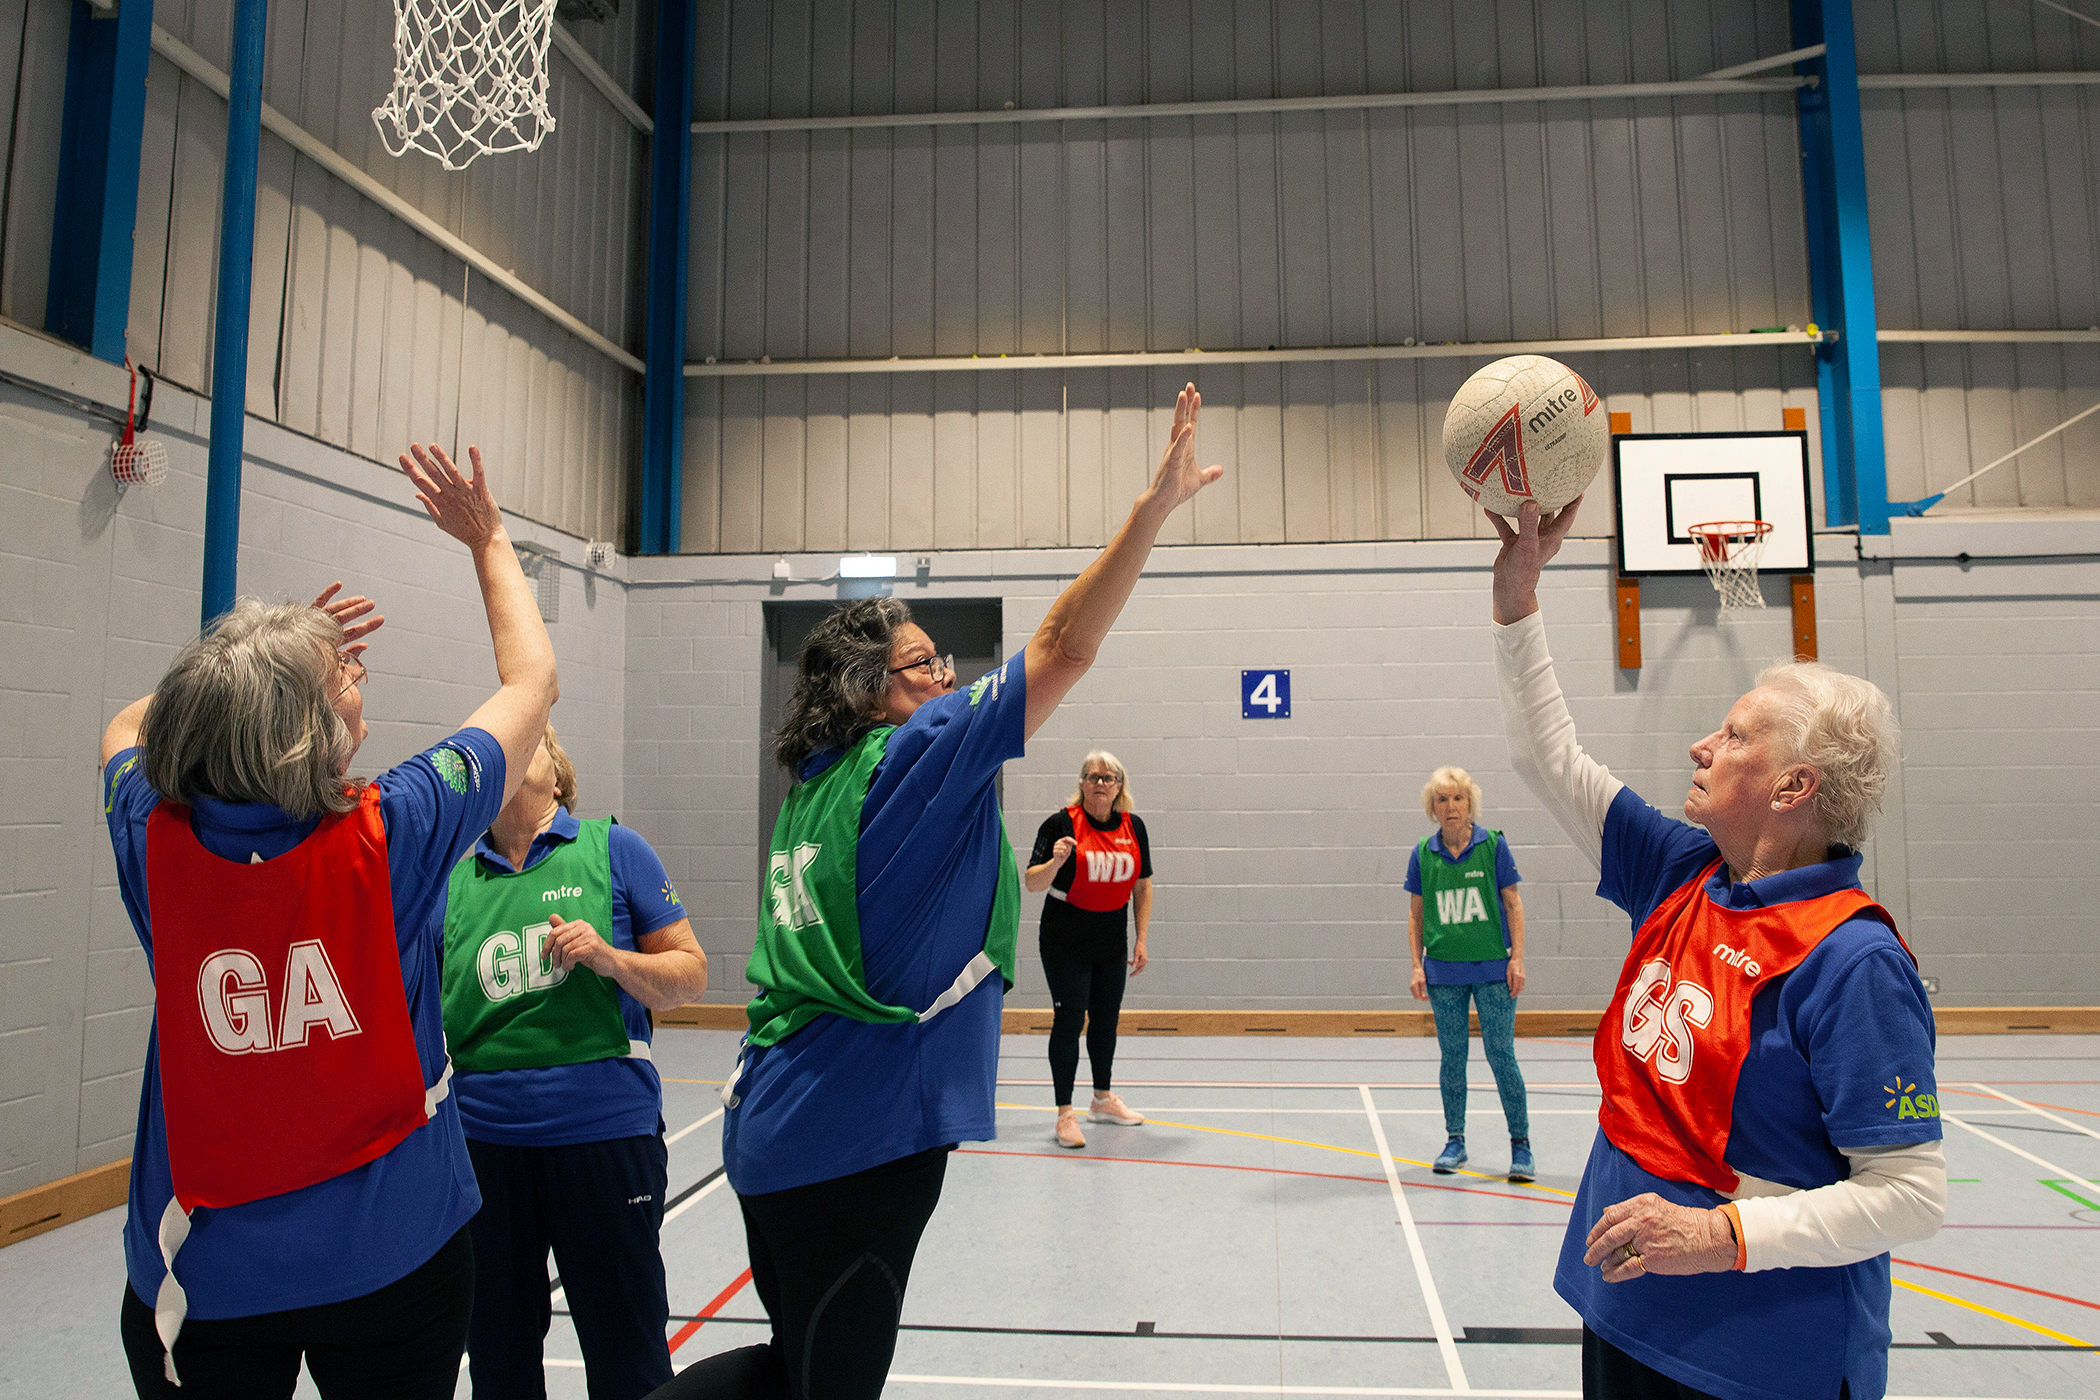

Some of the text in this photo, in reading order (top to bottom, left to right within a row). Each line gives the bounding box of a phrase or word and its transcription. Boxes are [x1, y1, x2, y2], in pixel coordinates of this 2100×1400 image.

[1528, 388, 1577, 434] mitre
[1250, 674, 1282, 713] 4
[1085, 850, 1135, 883] WD
[542, 885, 583, 902] mitre
[770, 841, 824, 932] GK
[1435, 886, 1489, 926] WA
[476, 920, 570, 1003] GD
[1712, 943, 1761, 977] mitre
[197, 938, 363, 1056] GA
[1621, 957, 1714, 1085] GS
[1898, 1094, 1940, 1120] ASD
[628, 1194, 652, 1205] HAD
